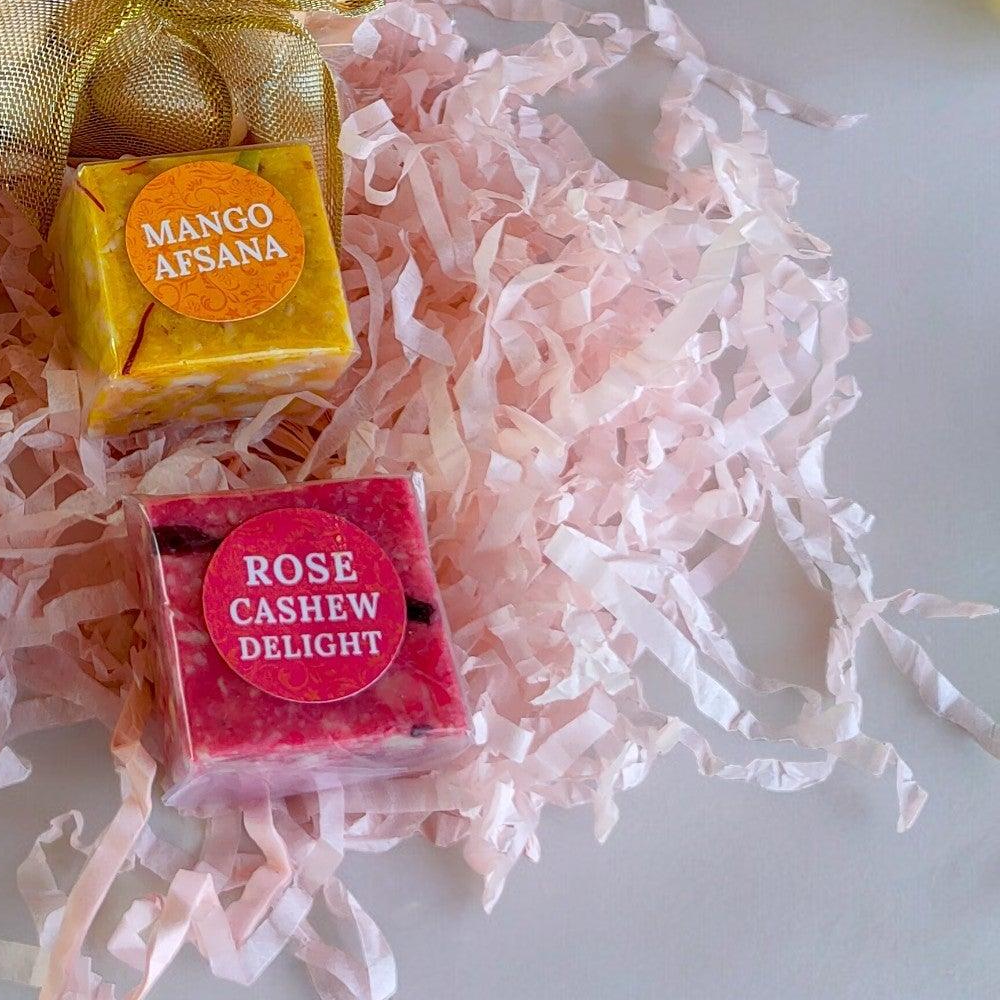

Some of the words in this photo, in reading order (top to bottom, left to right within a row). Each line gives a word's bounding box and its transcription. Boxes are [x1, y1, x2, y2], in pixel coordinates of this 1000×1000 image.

[141, 202, 274, 249] MANGO
[154, 234, 289, 281] AFSANA
[243, 551, 358, 587] ROSE
[229, 592, 381, 627] CASHEW
[237, 630, 383, 662] DELIGHT
